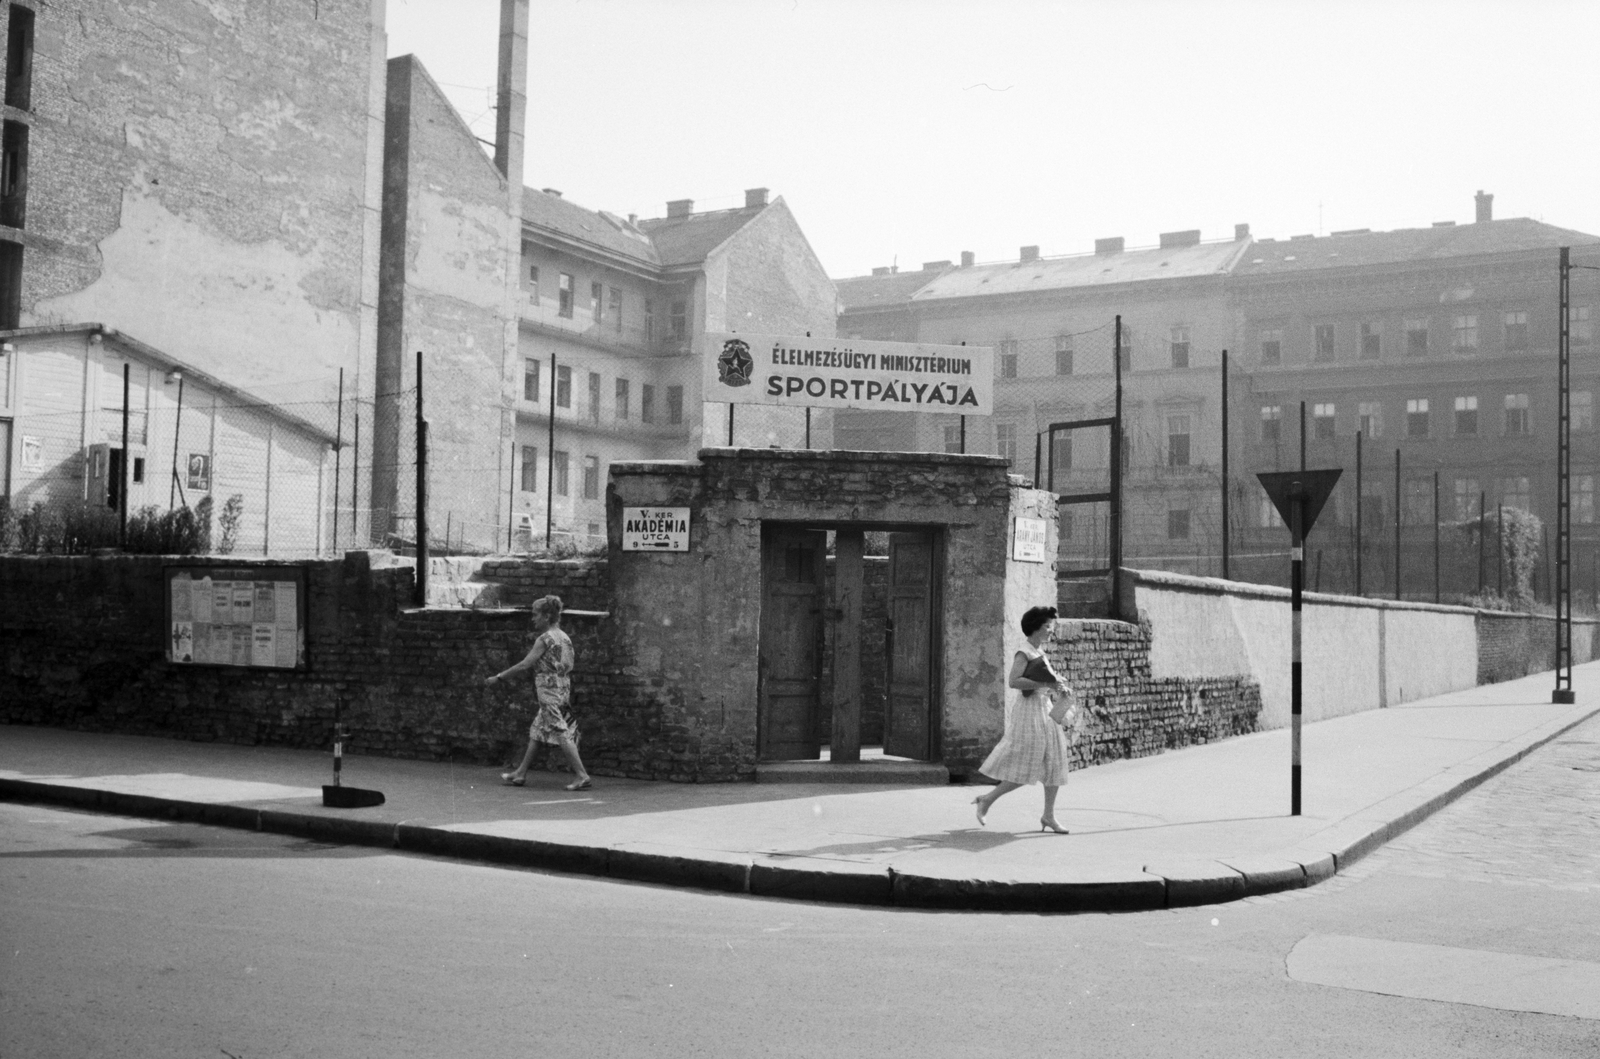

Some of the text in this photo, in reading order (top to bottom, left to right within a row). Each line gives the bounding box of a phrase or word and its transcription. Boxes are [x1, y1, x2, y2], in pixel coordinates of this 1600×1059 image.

[772, 342, 971, 375] ÉLELMEZÉSÜGYI MINISZTÉRIUM
[767, 375, 979, 406] SPORTPÁLYÁJA
[640, 510, 651, 518] V.
[626, 518, 686, 533] AKADÉMIA
[673, 541, 679, 549] 5
